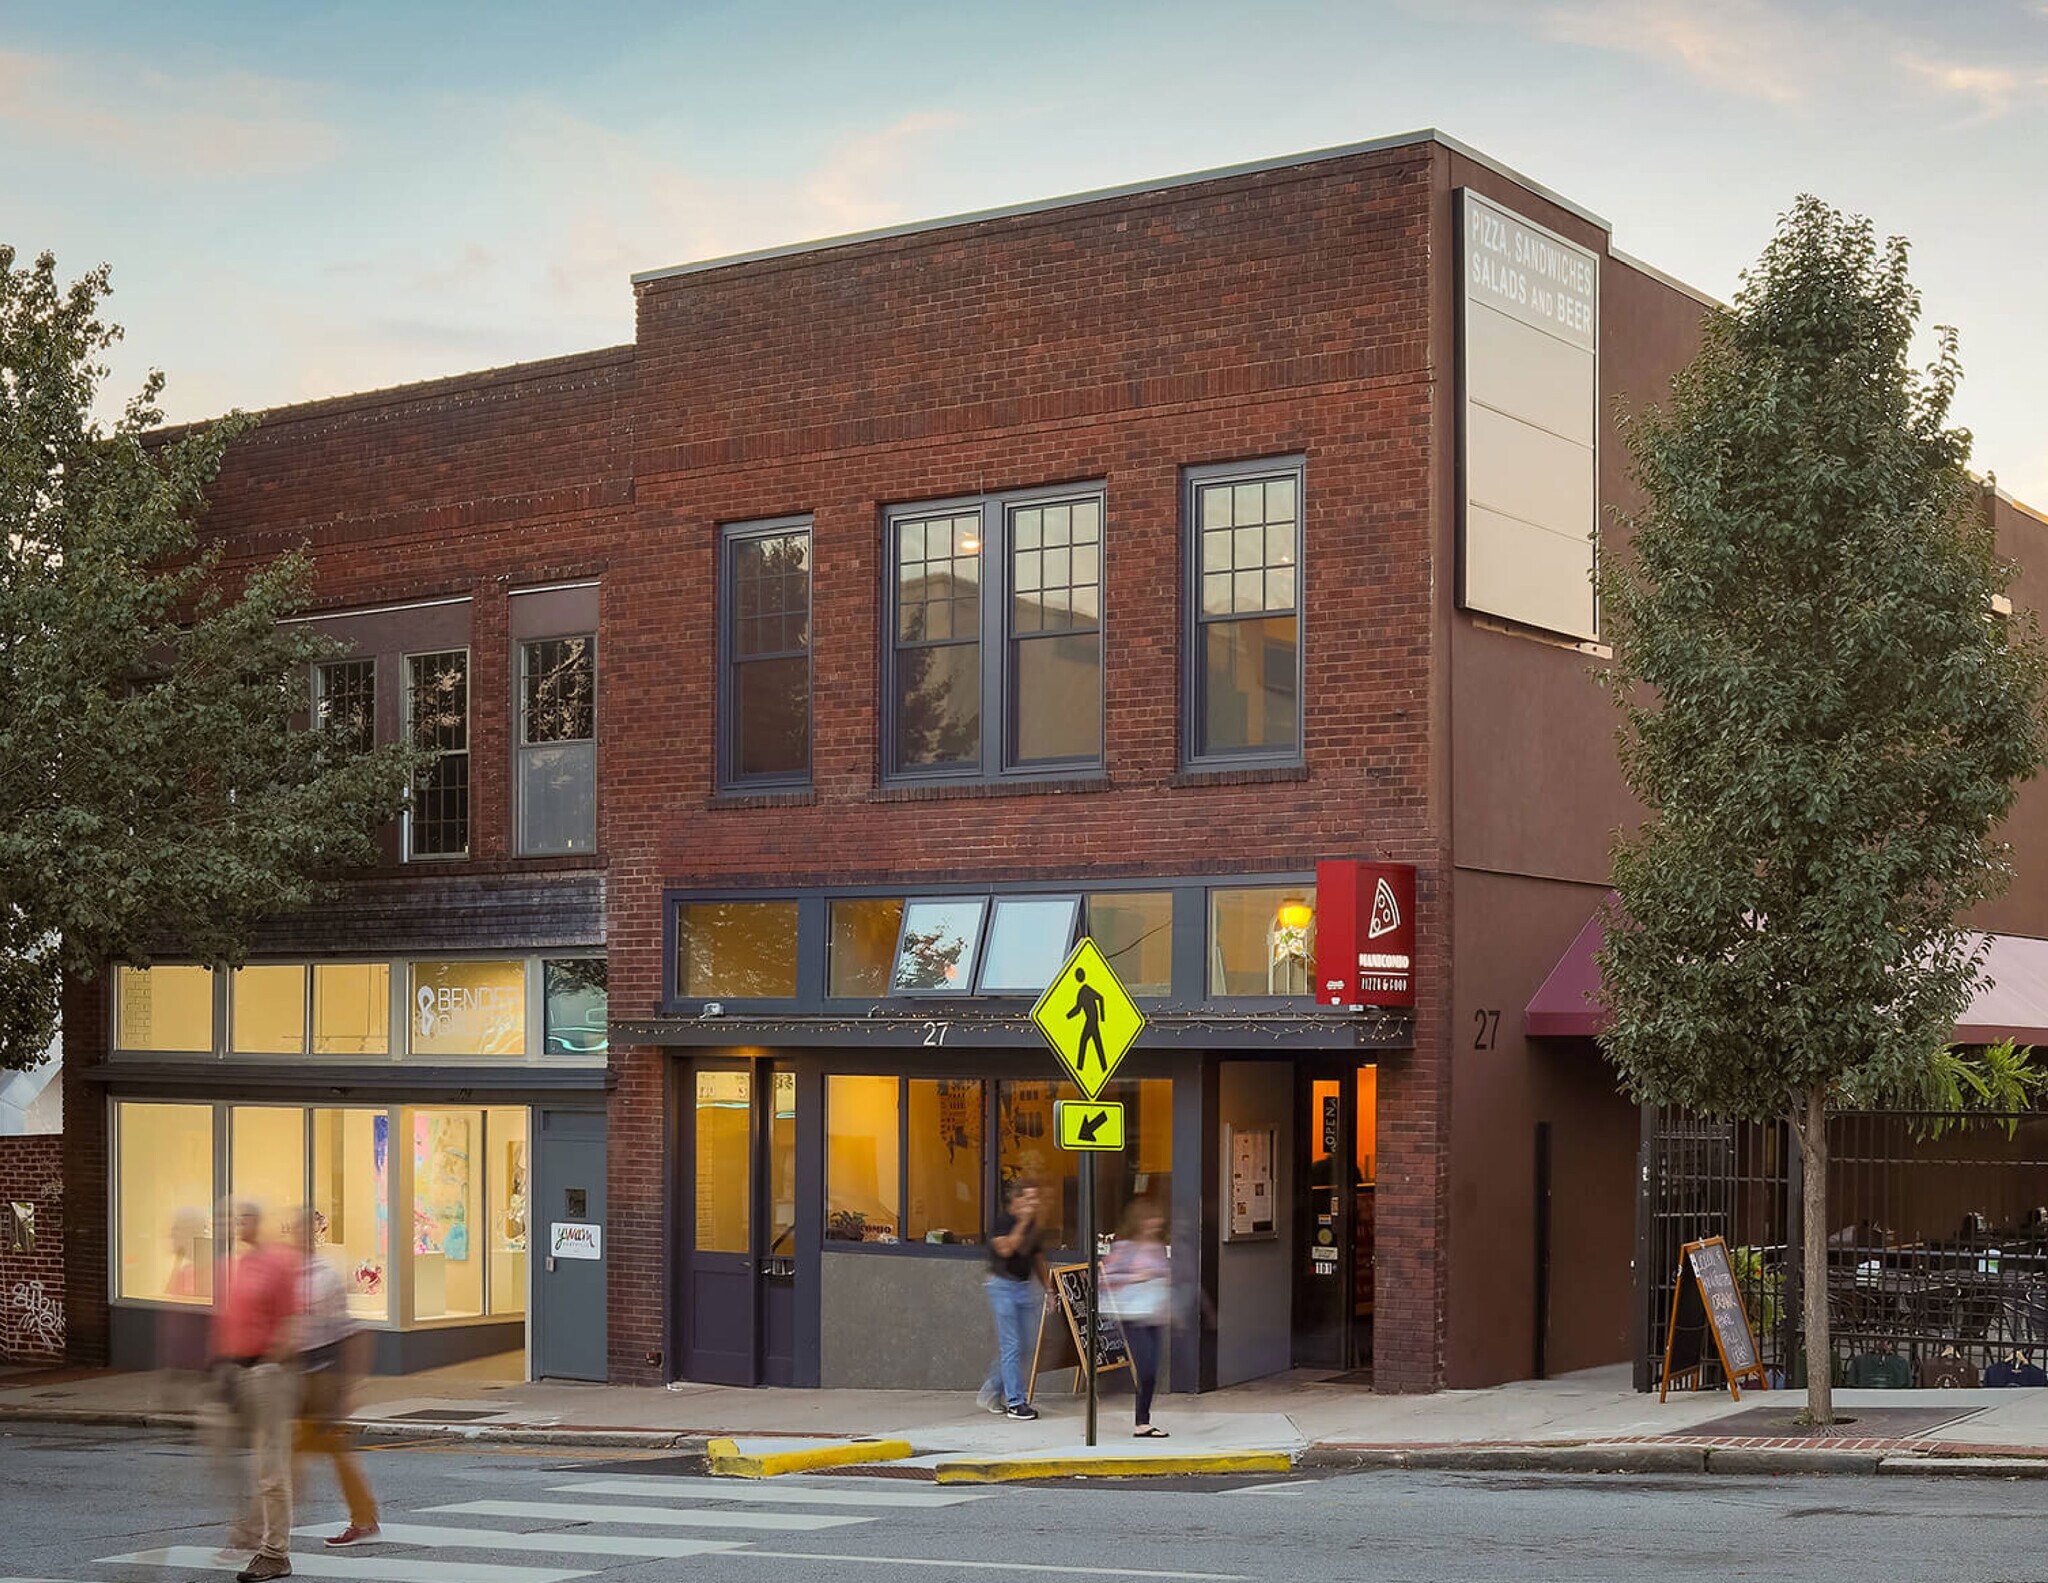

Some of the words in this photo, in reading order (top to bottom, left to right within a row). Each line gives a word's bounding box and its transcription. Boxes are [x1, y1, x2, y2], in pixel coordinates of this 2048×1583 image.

[1471, 210, 1511, 262] PIZZA,
[1514, 231, 1592, 297] SANDWICHES
[1472, 251, 1527, 304] SALADS
[1530, 286, 1553, 317] AND
[1557, 294, 1592, 334] BEER
[437, 987, 520, 1012] BENDER
[923, 1021, 948, 1046] 27
[1474, 1008, 1501, 1051] 27
[1325, 1106, 1337, 1146] OPEN
